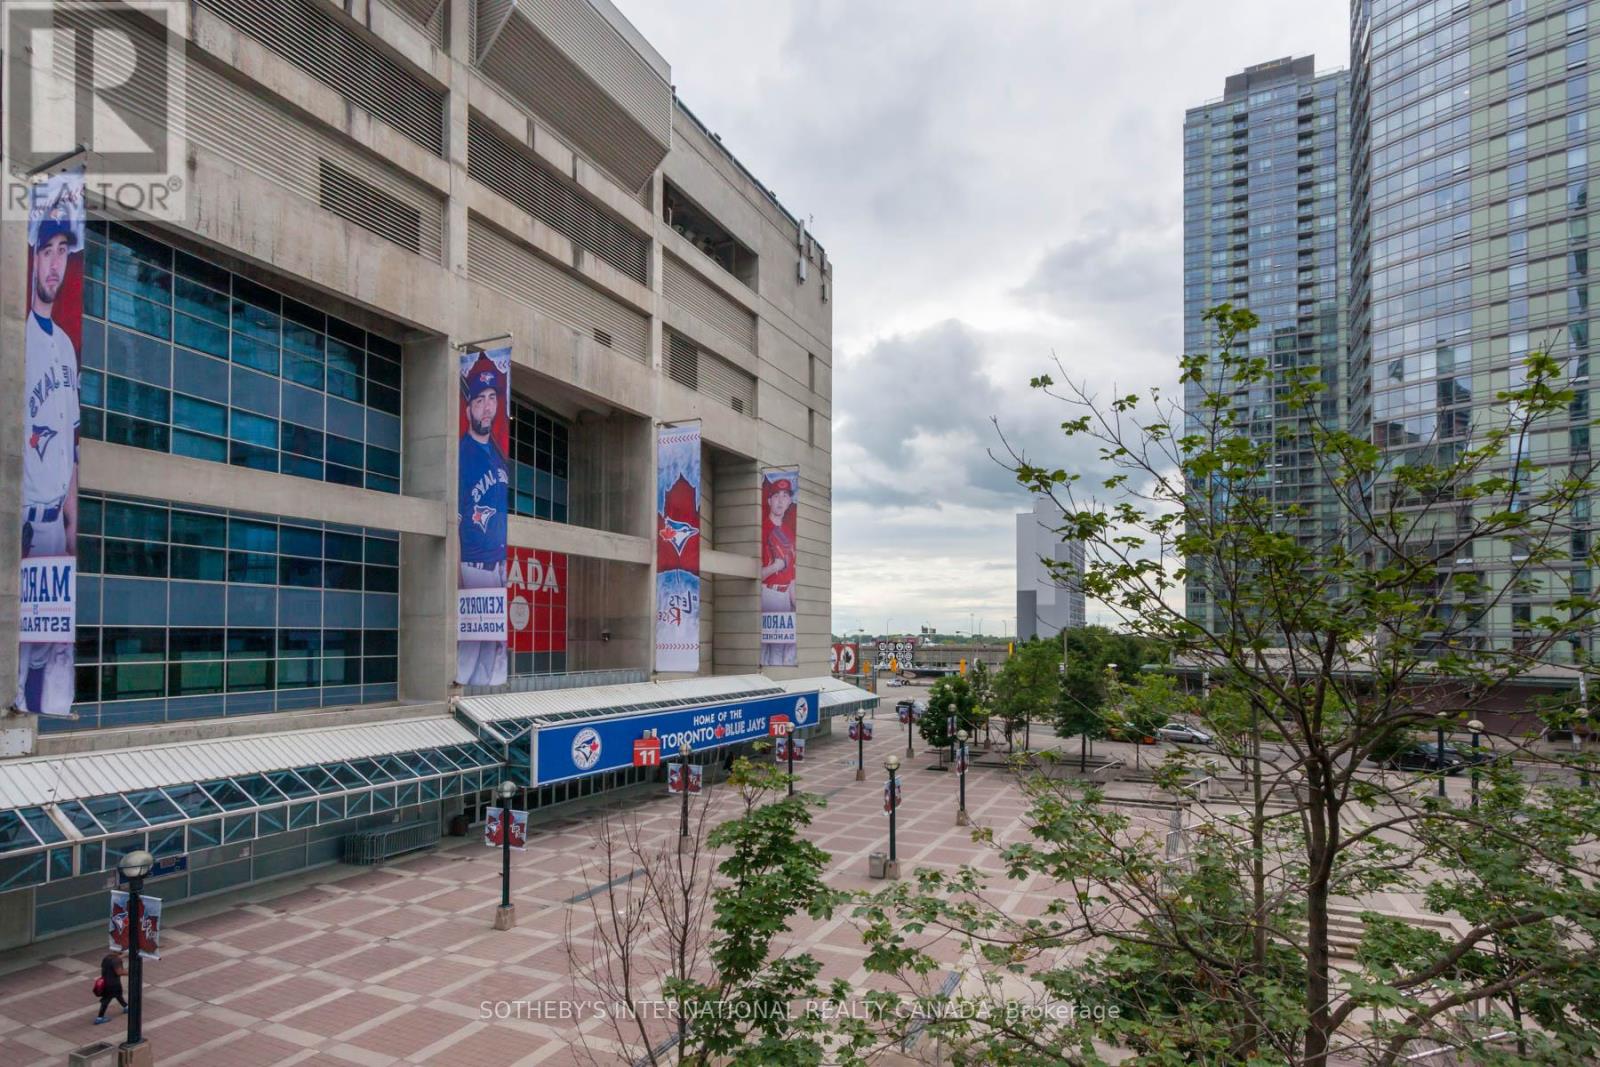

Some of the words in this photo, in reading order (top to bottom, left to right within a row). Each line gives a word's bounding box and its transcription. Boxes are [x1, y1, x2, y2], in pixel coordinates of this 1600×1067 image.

[693, 713, 715, 727] HOME
[718, 711, 727, 724] OF
[730, 709, 743, 720] THE
[661, 727, 714, 750] TORONTO
[725, 720, 746, 737] BLUE
[747, 716, 766, 733] JAYS
[773, 723, 785, 736] 10
[639, 750, 656, 765] 11
